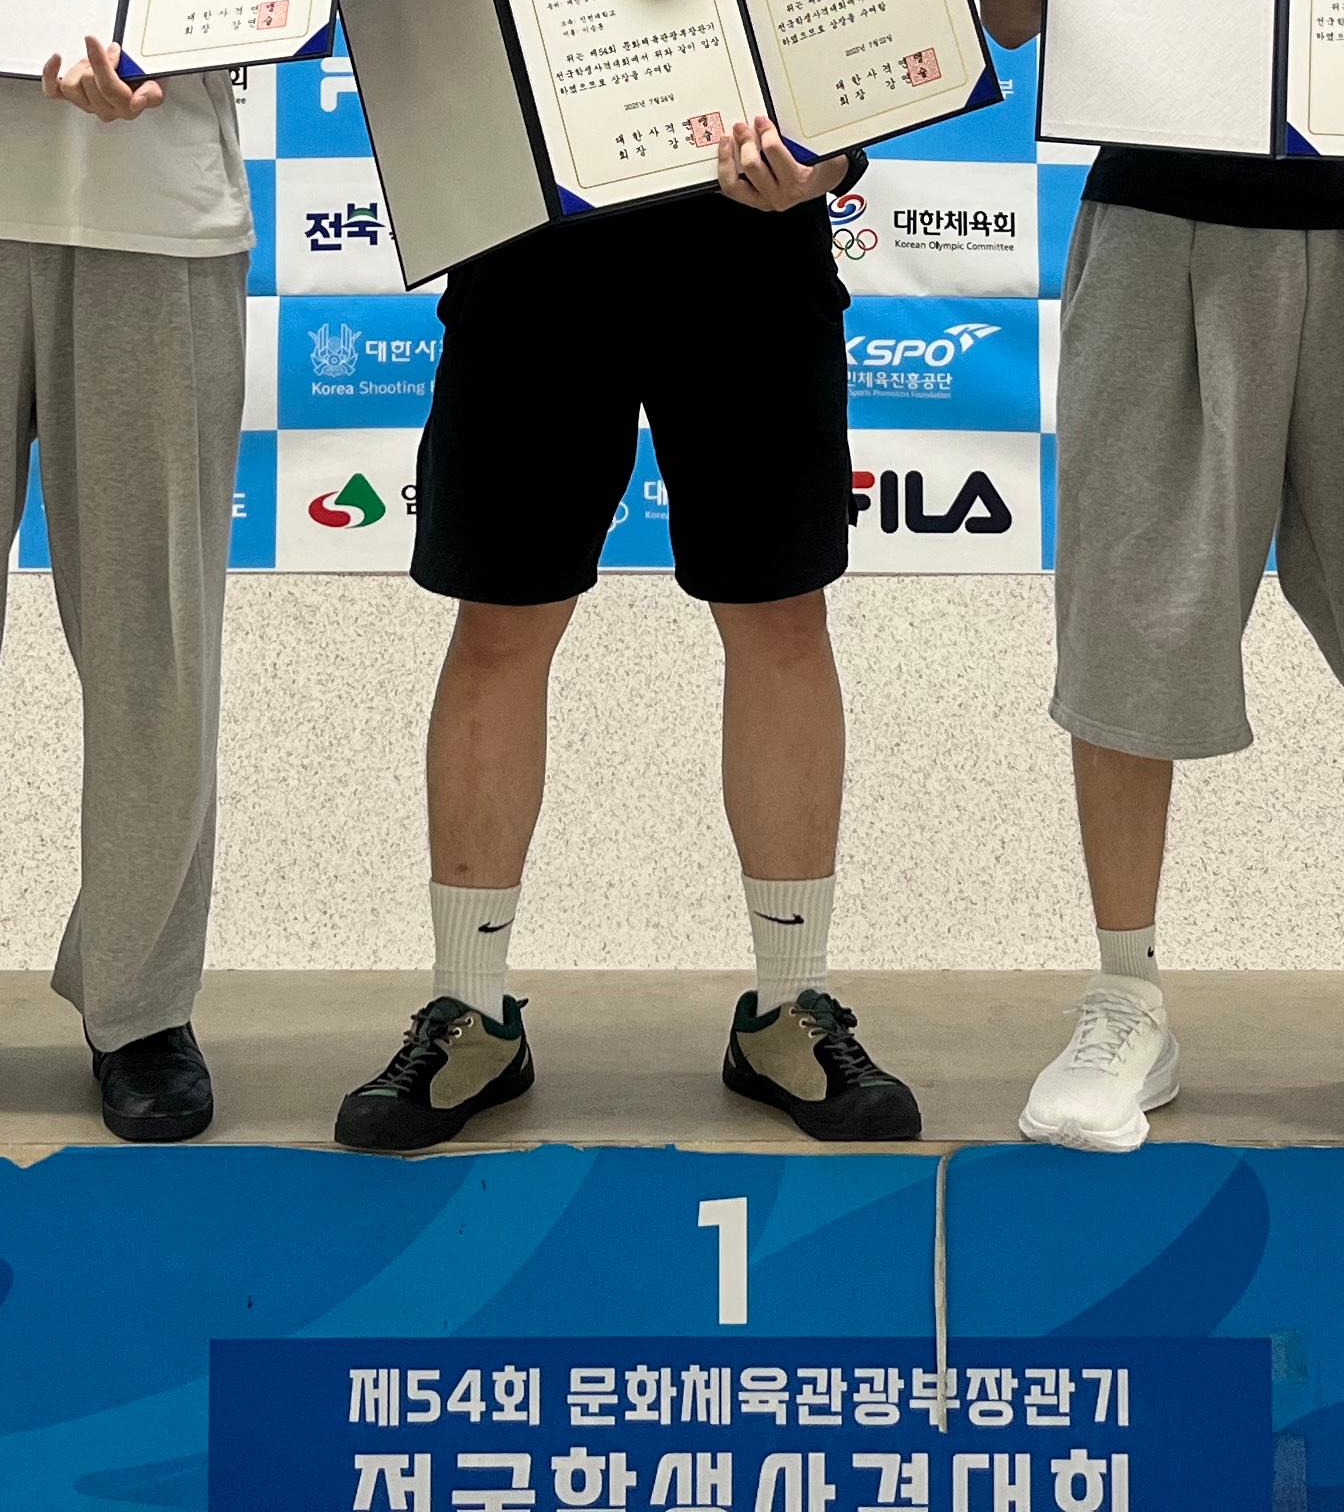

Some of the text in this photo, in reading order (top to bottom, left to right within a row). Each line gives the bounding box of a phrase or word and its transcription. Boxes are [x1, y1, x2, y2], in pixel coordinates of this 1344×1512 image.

[305, 203, 386, 251] 전북
[894, 210, 1015, 238] 대한체육회
[895, 240, 1014, 251] Korean Olympic Committee
[365, 340, 442, 363] 대한사
[312, 381, 425, 395] Korea Shooting
[847, 372, 952, 390] 체육진흥공단
[698, 1196, 749, 1325] 1
[348, 1366, 1131, 1430] 제54회 문화체육관광부장관기
